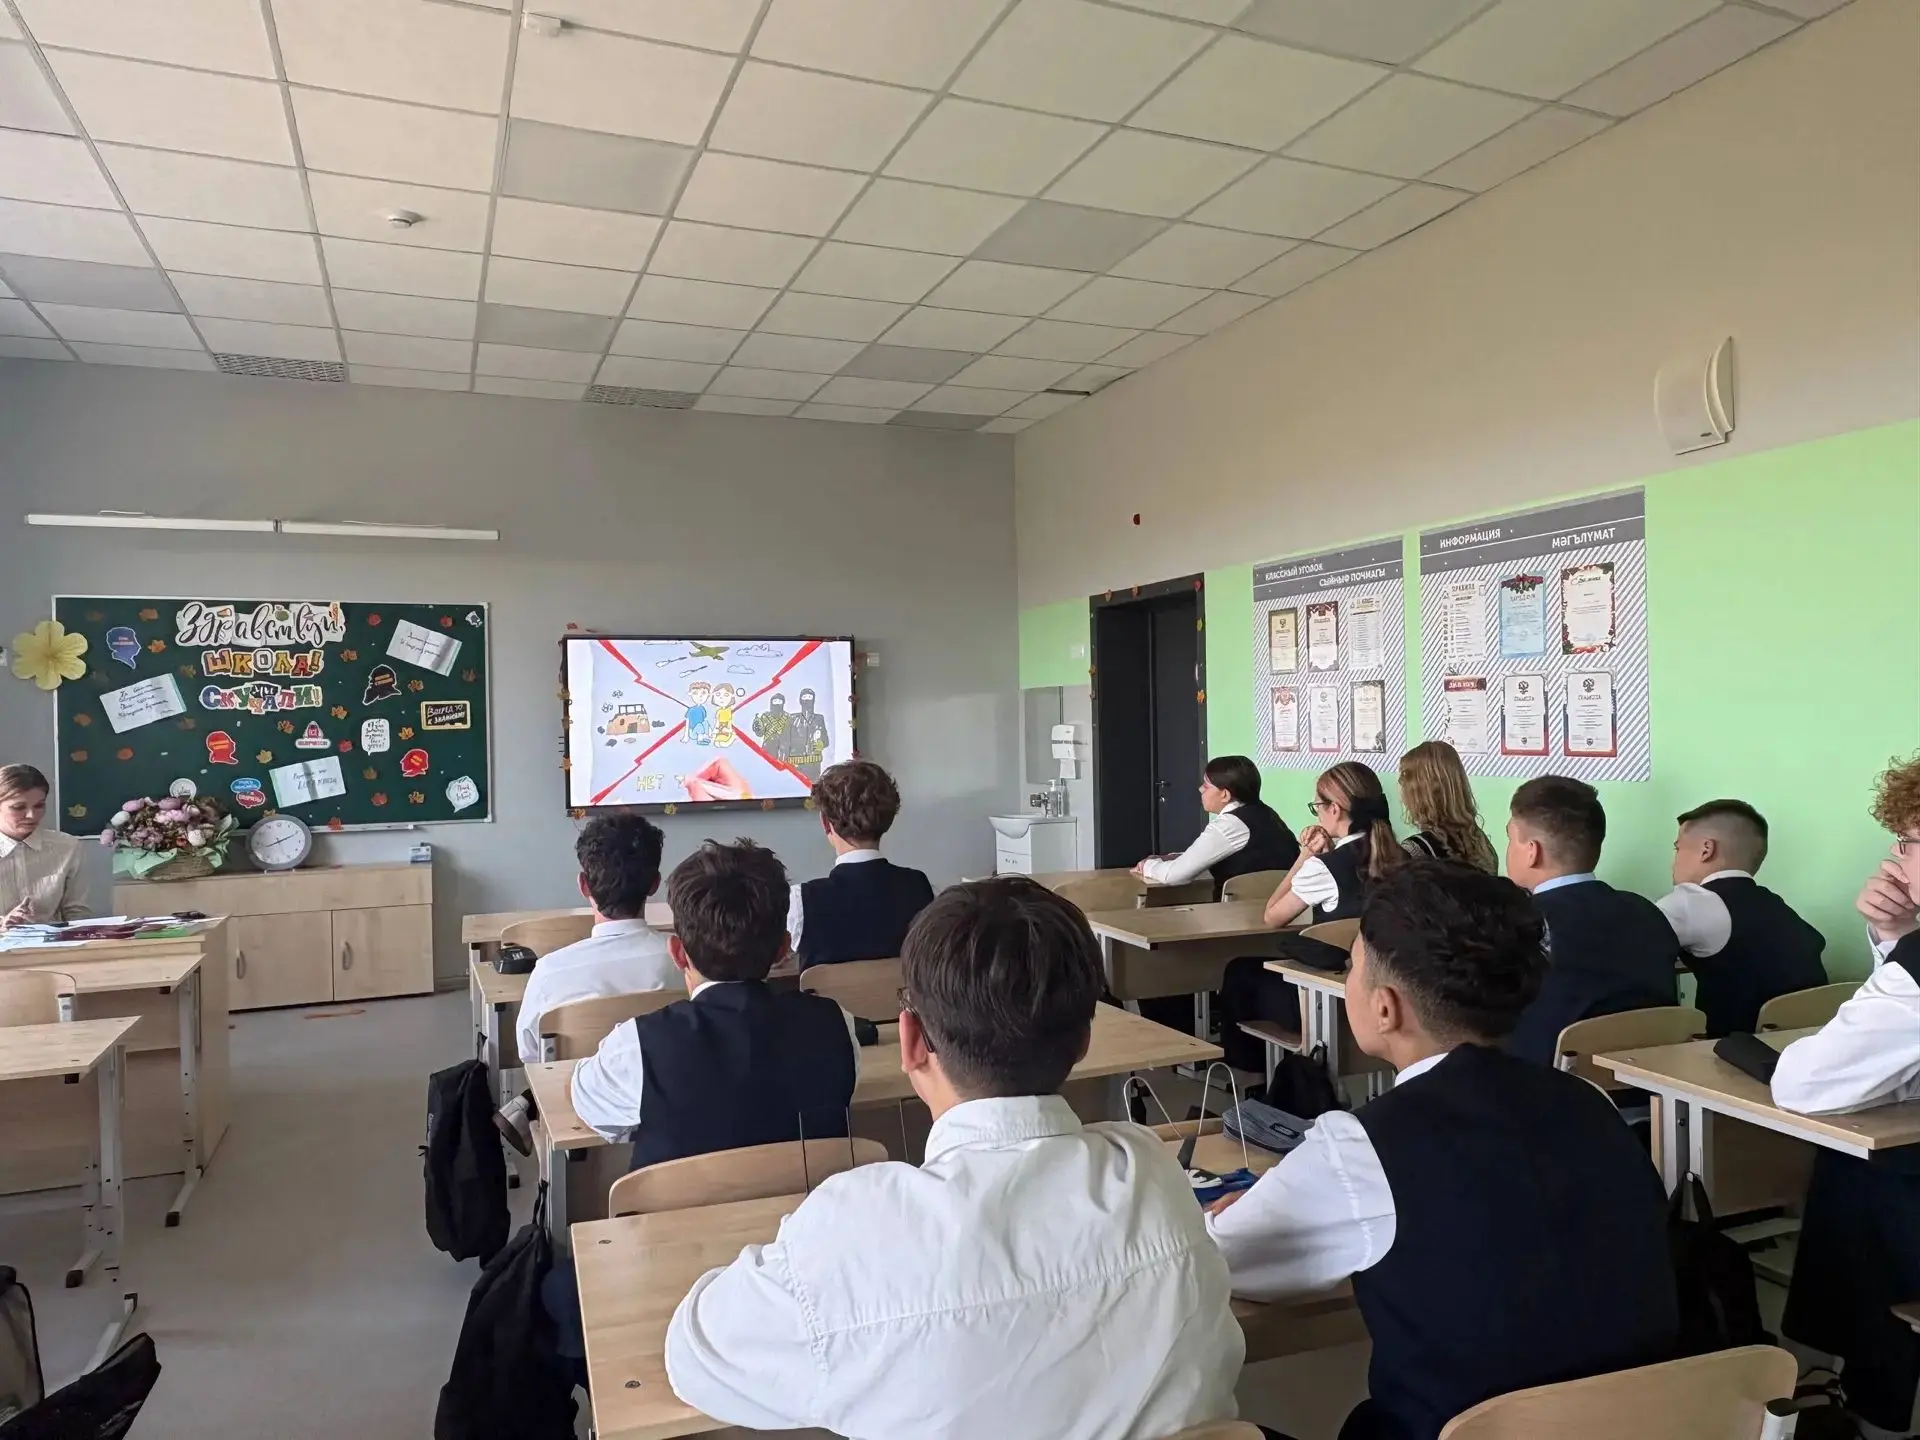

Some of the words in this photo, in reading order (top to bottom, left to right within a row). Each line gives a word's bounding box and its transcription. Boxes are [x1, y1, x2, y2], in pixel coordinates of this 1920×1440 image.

[1439, 528, 1501, 549] ИНФОРМАЦИЯ
[1551, 527, 1616, 549] МӘГЪЛҮМАТ
[203, 649, 323, 677] ШКОЛА!
[636, 773, 665, 792] НЕТ
